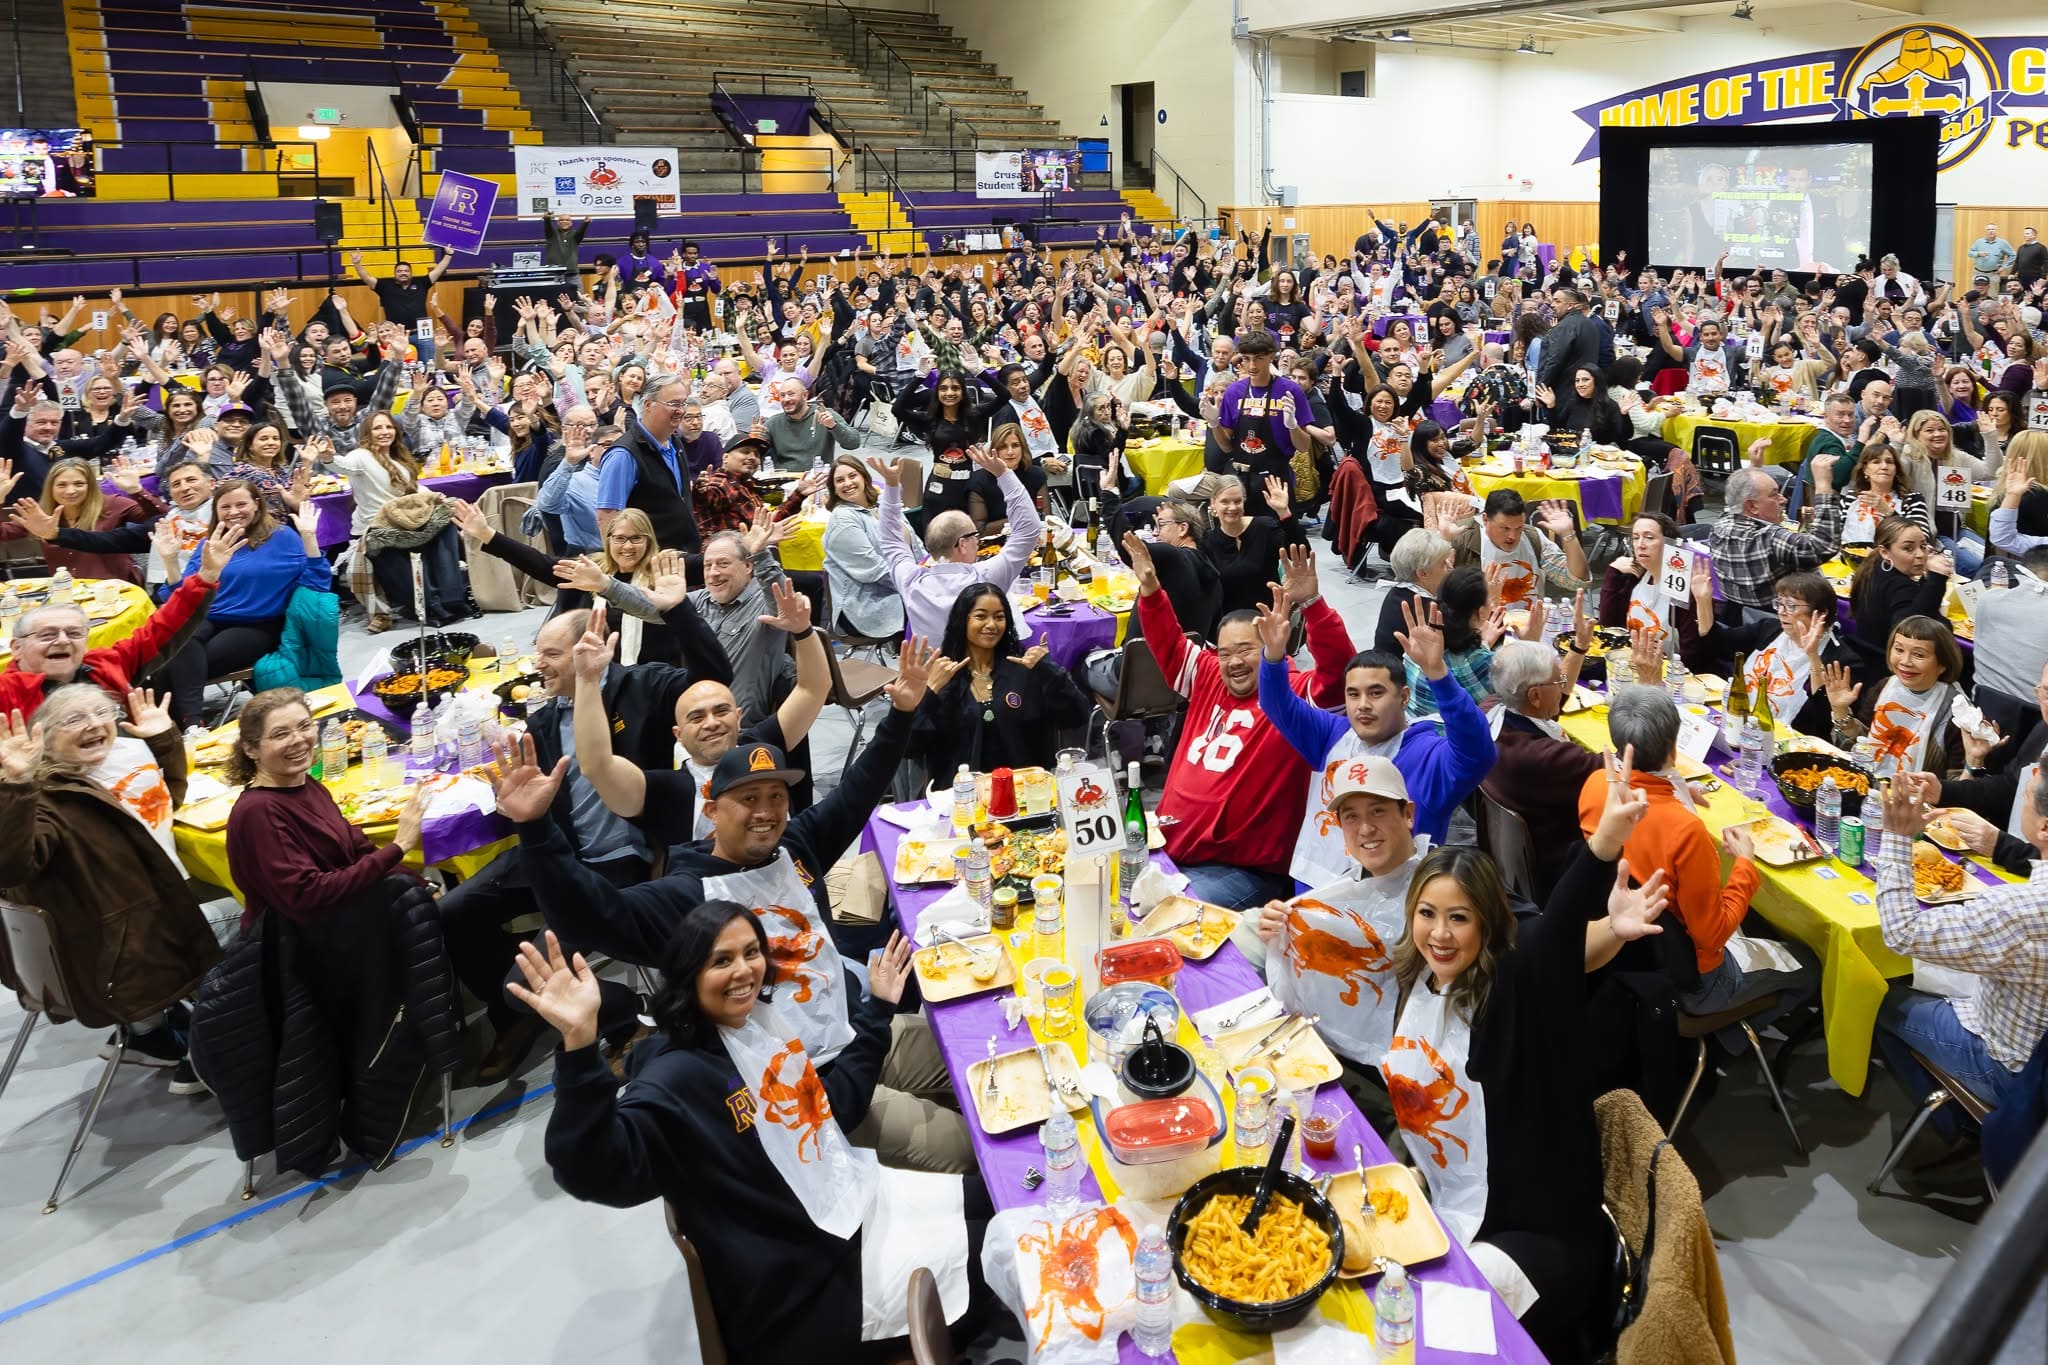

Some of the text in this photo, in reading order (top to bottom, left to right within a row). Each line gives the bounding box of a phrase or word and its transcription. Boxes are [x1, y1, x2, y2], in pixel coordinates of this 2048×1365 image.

[2008, 47, 2048, 95] C
[1704, 72, 1752, 120] OF
[1757, 61, 1836, 112] THE
[558, 157, 584, 167] Thank
[585, 156, 601, 164] you
[994, 171, 1021, 179] Crusa
[977, 182, 1015, 190] Student
[449, 185, 479, 216] R
[62, 396, 77, 406] 22
[1942, 489, 1967, 503] 48
[1664, 574, 1686, 592] 49
[1075, 815, 1117, 846] 50
[724, 1086, 758, 1134] R
